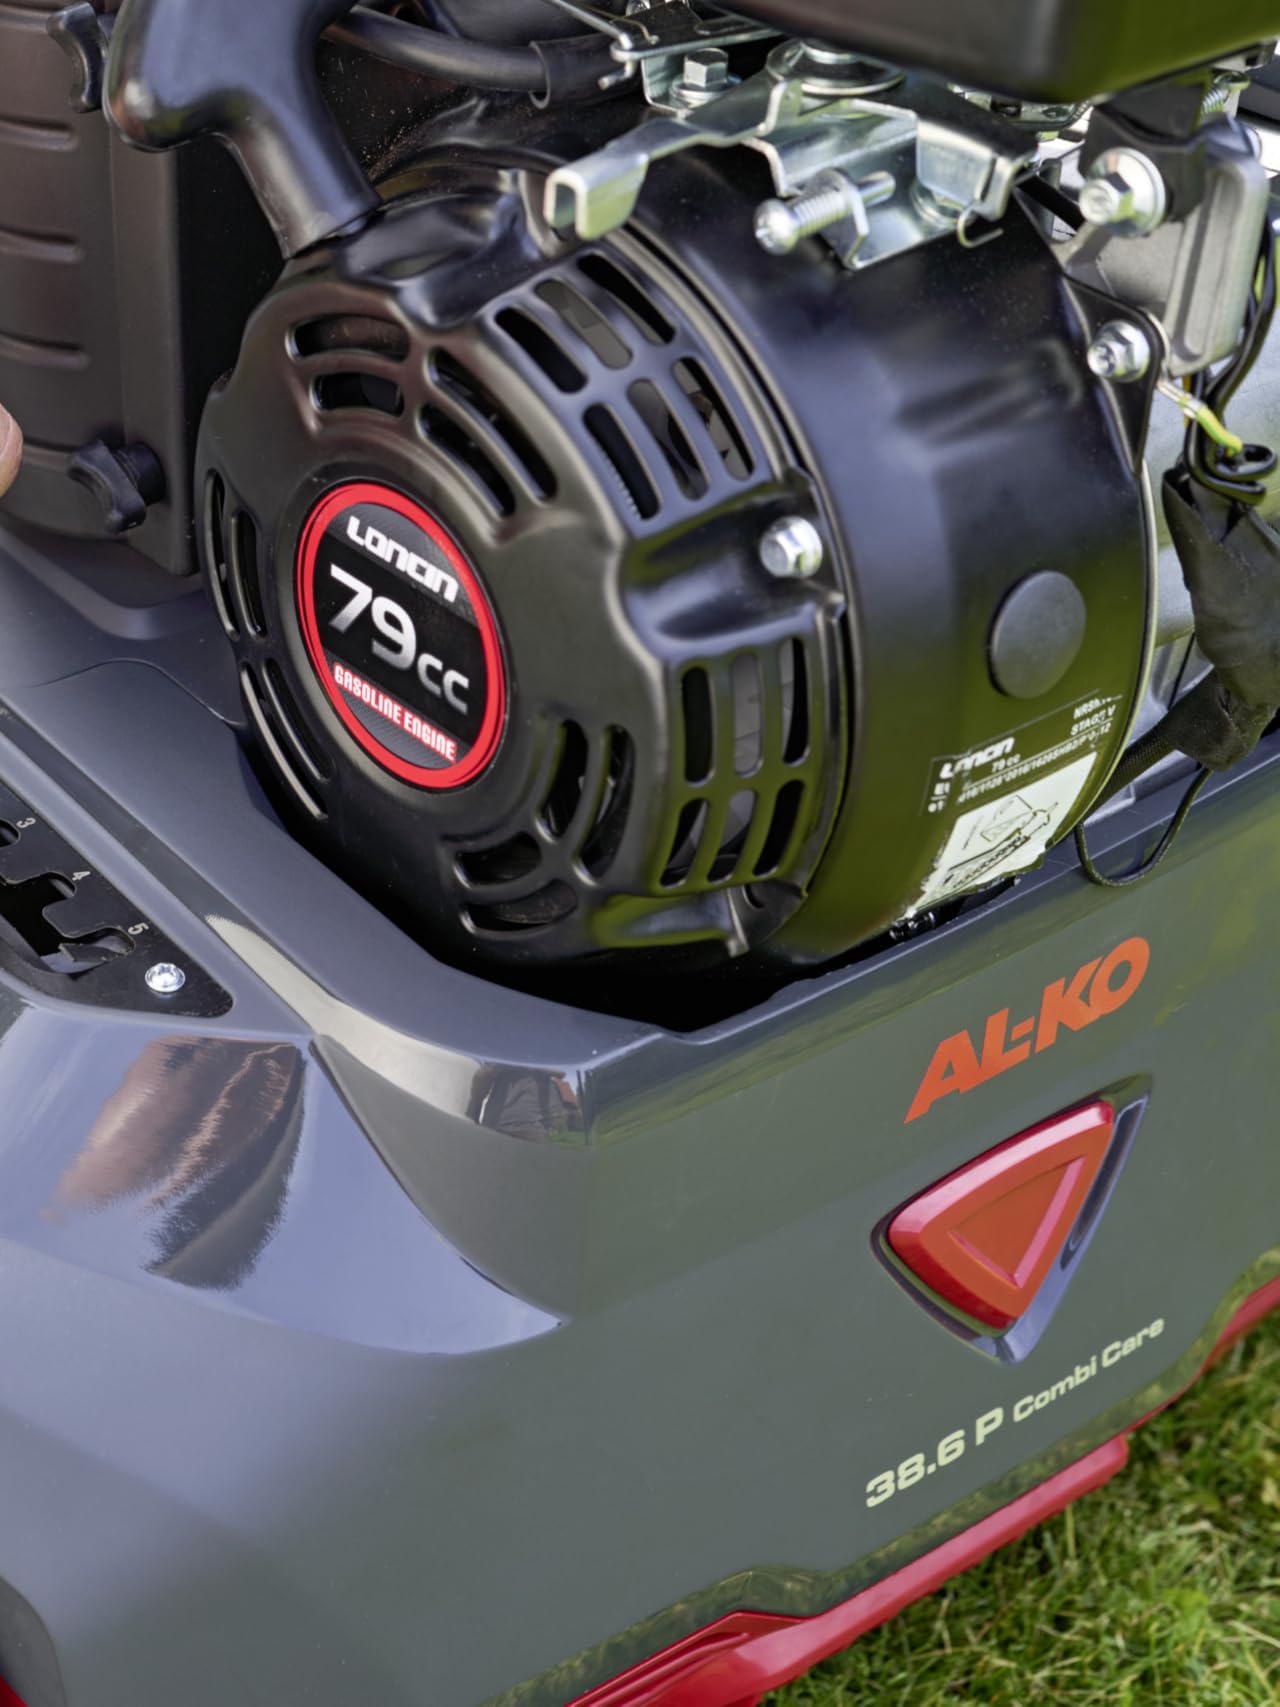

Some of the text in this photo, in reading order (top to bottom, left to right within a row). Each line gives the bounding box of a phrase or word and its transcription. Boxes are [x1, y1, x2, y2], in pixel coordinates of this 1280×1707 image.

[334, 664, 456, 761] GASOLINE ENGINE
[16, 817, 37, 829] 3
[72, 870, 91, 882] 4
[127, 922, 149, 936] 5
[903, 936, 1150, 1125] AL-KO
[866, 1318, 1165, 1508] 38.6 P Combi Care
